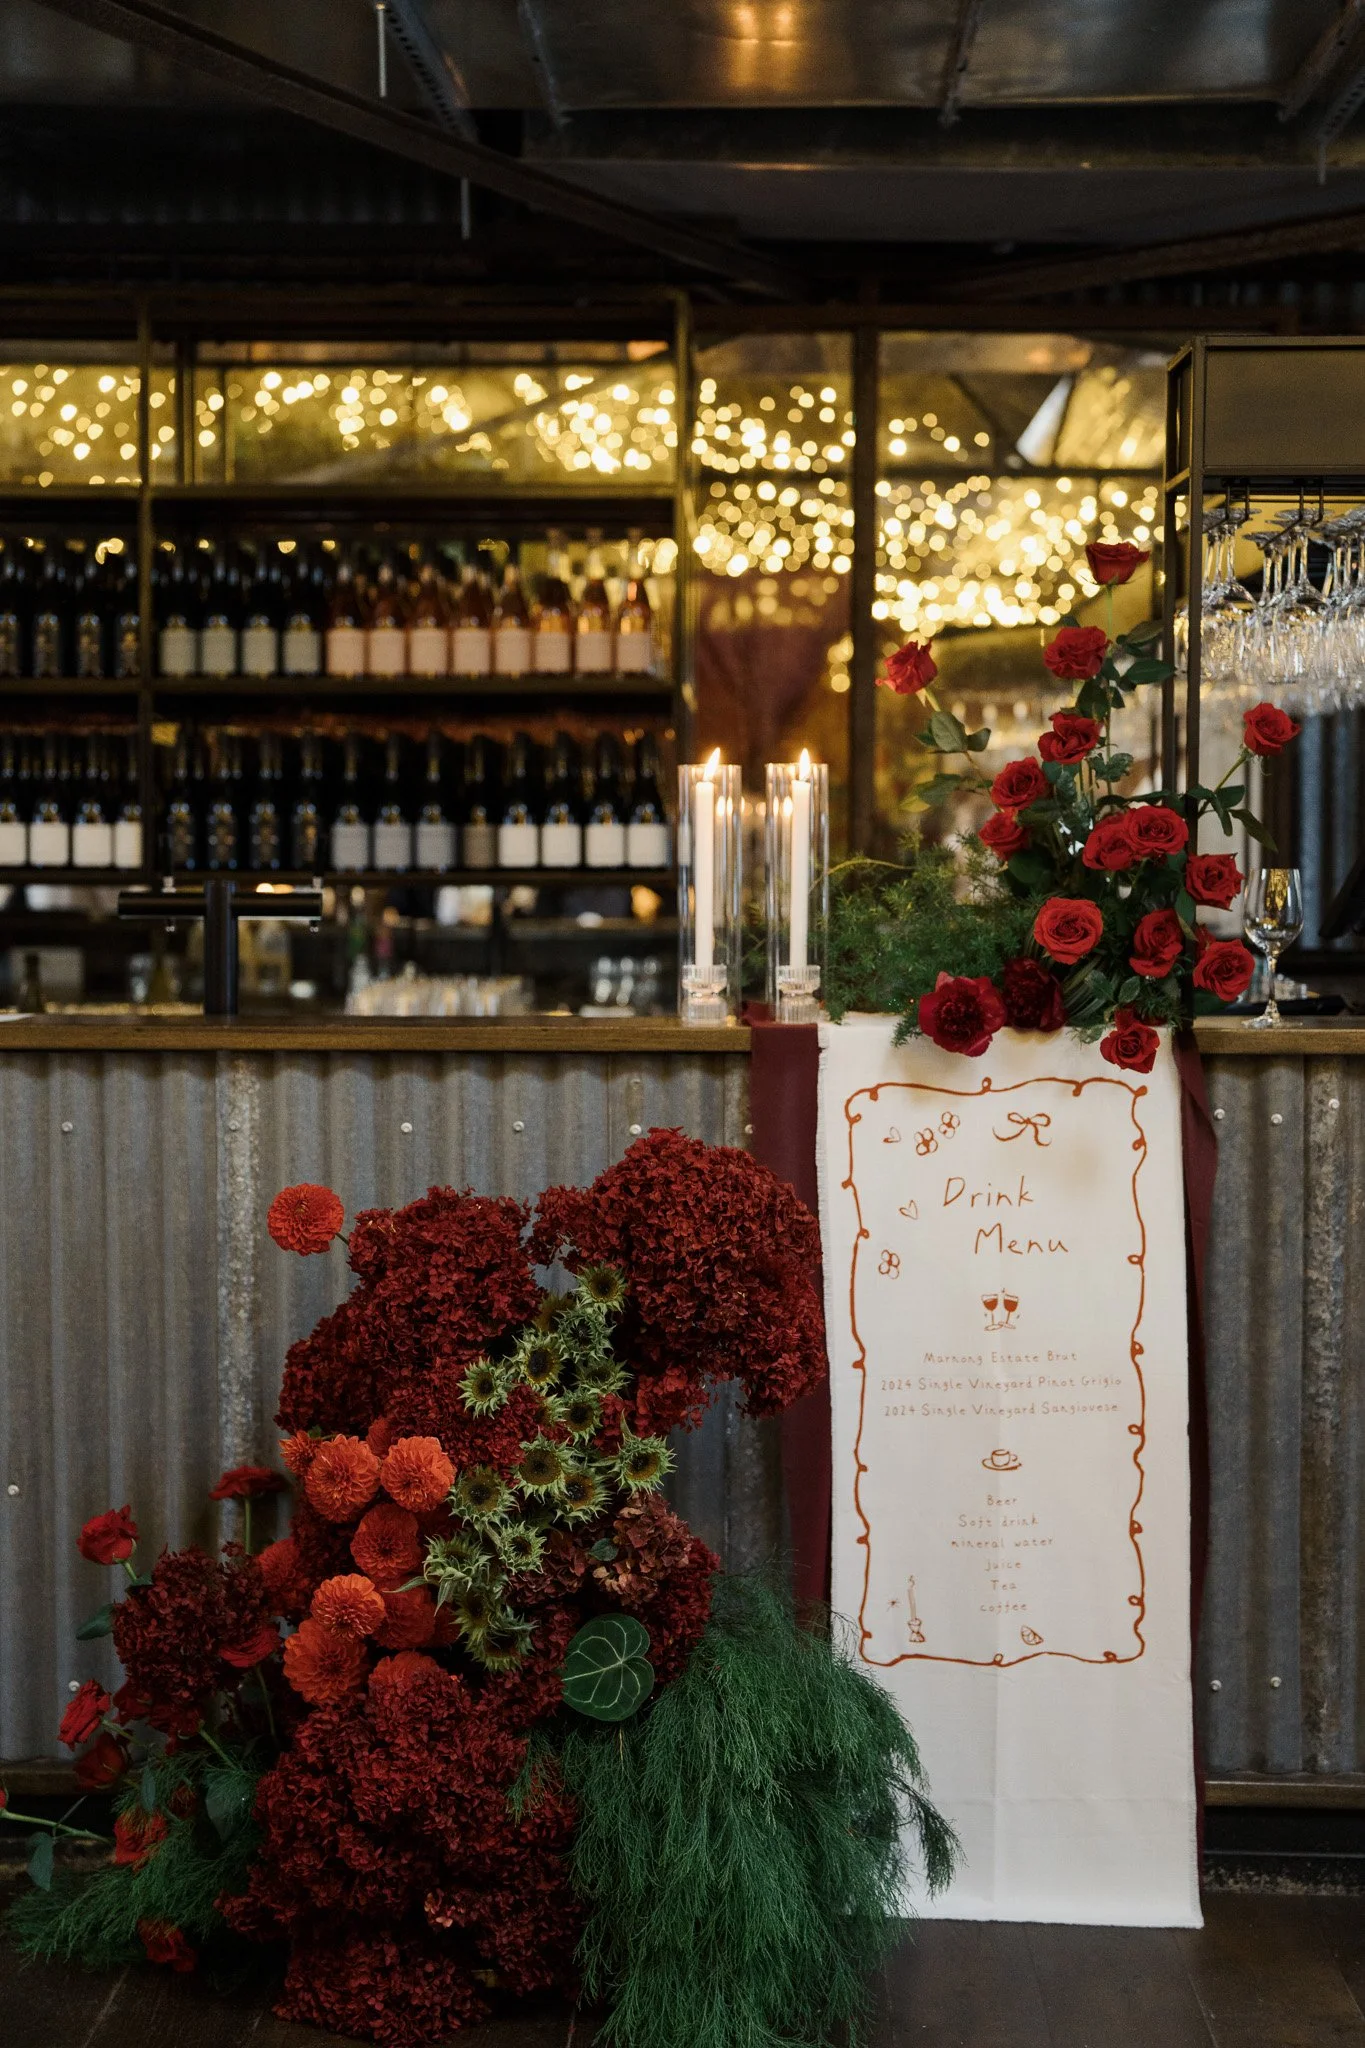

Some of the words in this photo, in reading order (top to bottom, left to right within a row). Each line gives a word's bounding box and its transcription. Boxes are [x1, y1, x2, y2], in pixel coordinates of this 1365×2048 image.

[943, 1175, 1034, 1207] Drink
[974, 1222, 1068, 1255] Menu
[923, 1352, 983, 1365] Marnong
[991, 1352, 1039, 1362] Estate
[1047, 1351, 1078, 1362] Brut
[880, 1380, 912, 1390] 2024
[918, 1378, 962, 1392] Single
[969, 1377, 1033, 1392] Vineyard
[1038, 1376, 1075, 1388] Pinot
[1081, 1376, 1122, 1390] Grigio
[884, 1406, 915, 1417] 2024
[921, 1404, 966, 1417] Single
[972, 1403, 1035, 1418] Vineyard
[1042, 1401, 1119, 1415] Sangiovese
[986, 1495, 1018, 1506] Beer
[958, 1514, 992, 1528] Soft
[1001, 1513, 1039, 1527] drink
[950, 1538, 1005, 1548] mineral
[1014, 1537, 1053, 1547] water
[990, 1579, 1017, 1591] Tea
